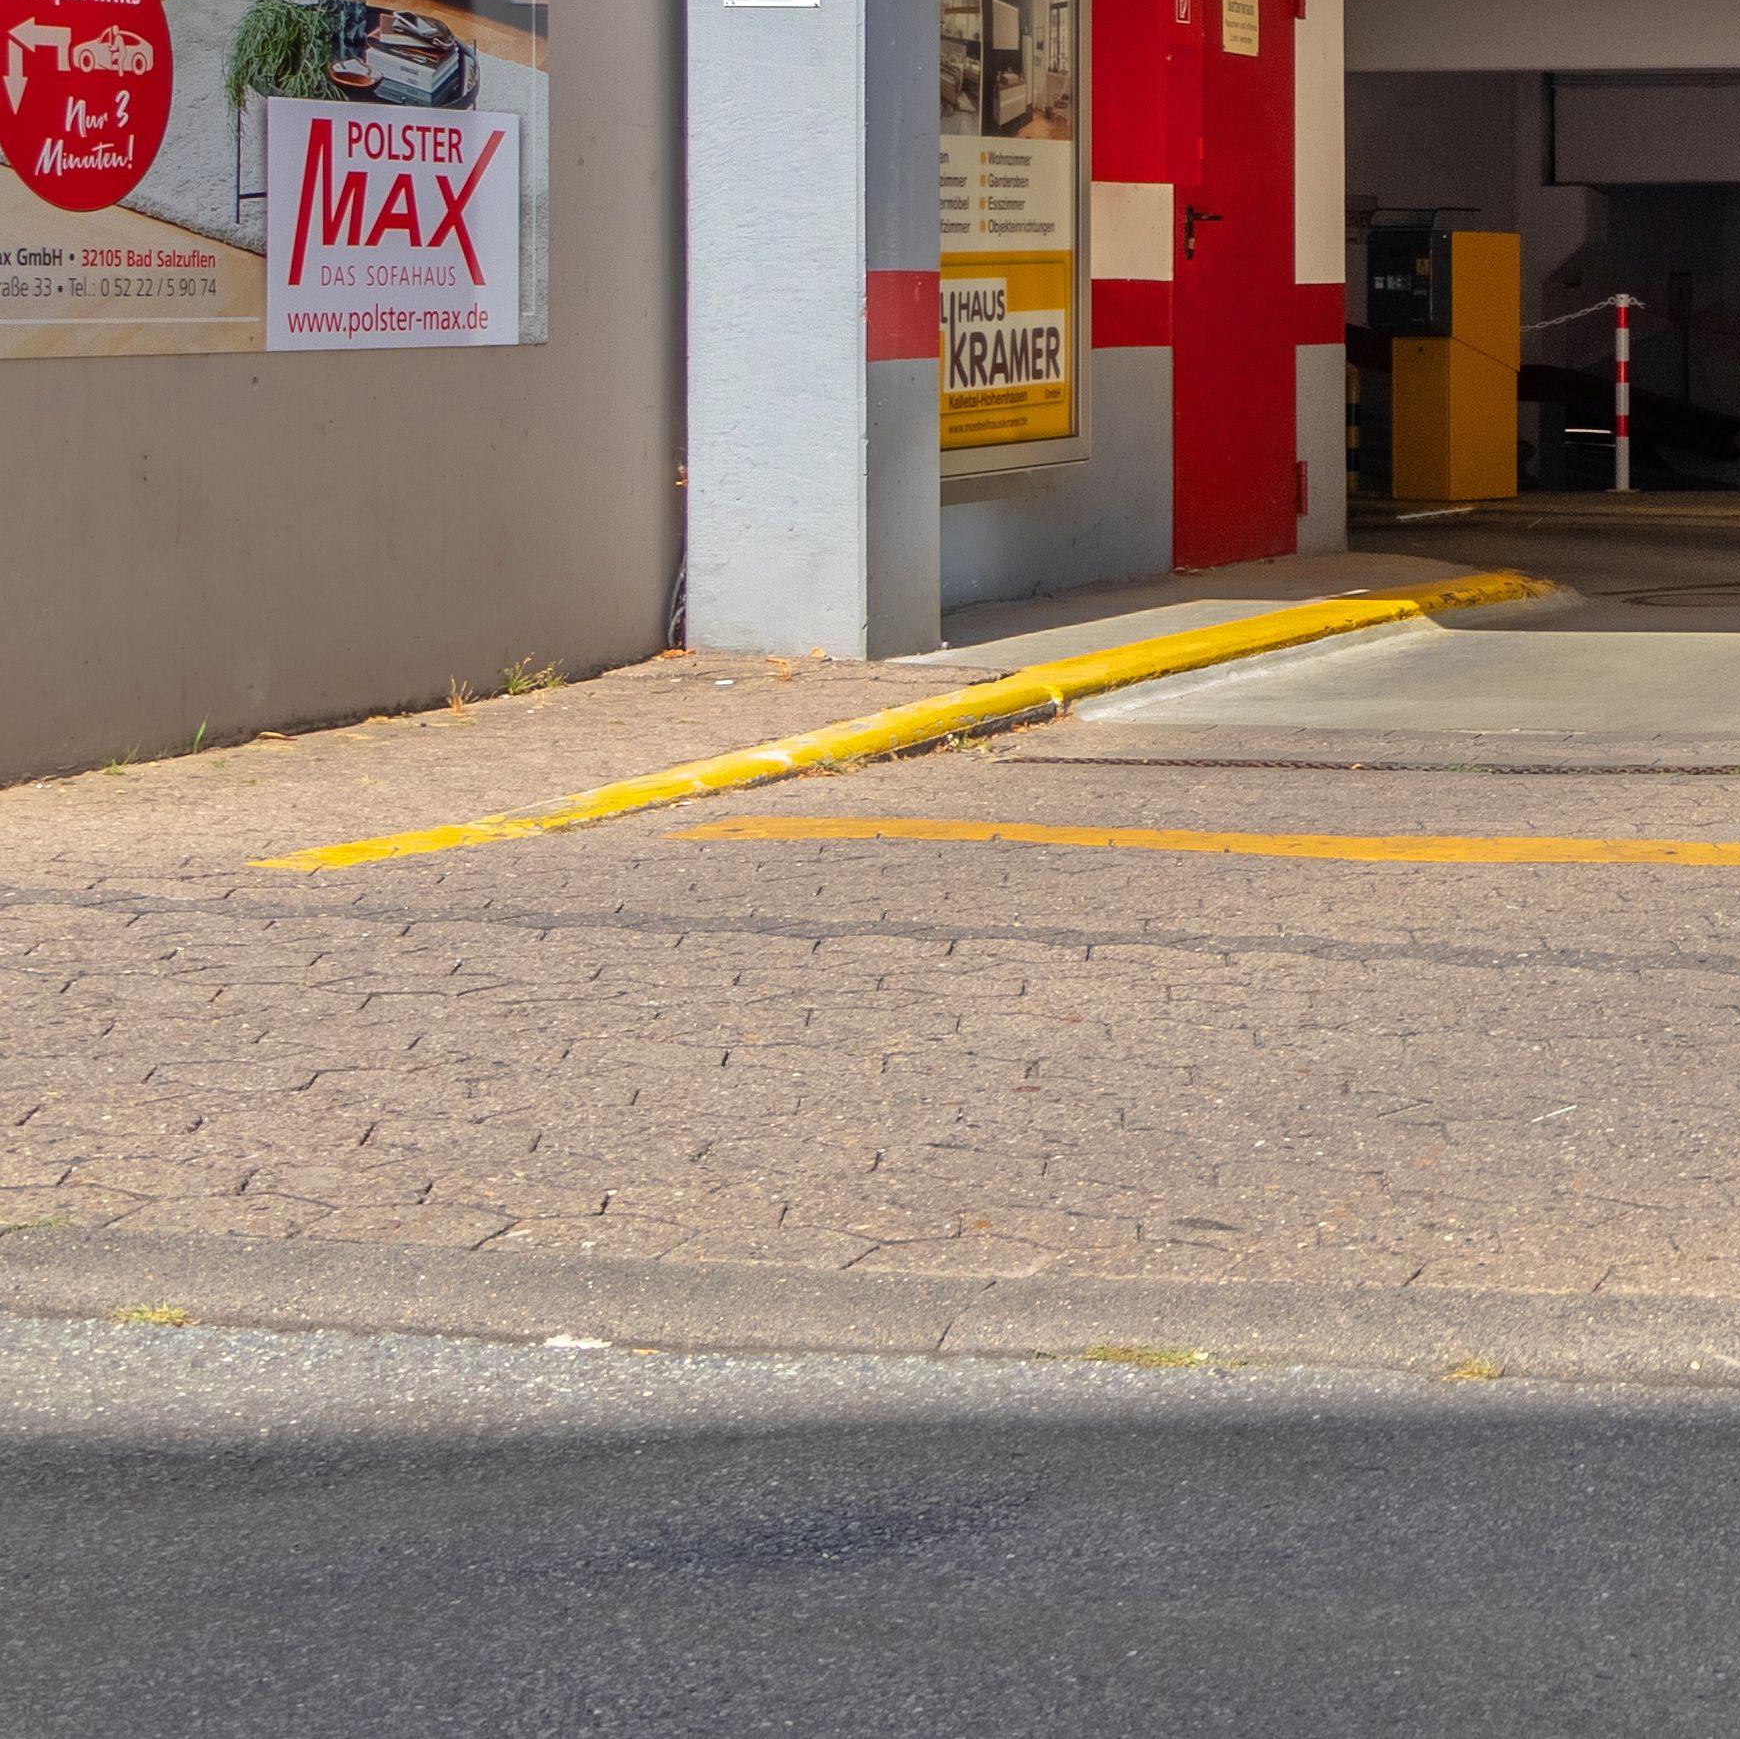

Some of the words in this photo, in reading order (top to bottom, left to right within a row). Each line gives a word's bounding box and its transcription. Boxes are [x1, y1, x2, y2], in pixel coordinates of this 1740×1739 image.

[65, 96, 109, 138] Nur
[115, 90, 131, 127] 3
[35, 134, 135, 177] Minuten!
[348, 121, 463, 164] POLSTER
[288, 118, 506, 286] MAX
[17, 247, 63, 267] GmbH
[81, 249, 122, 267] 32105
[126, 250, 152, 268] Bad
[157, 250, 216, 268] Salzuflen
[320, 265, 356, 287] DAS
[366, 265, 456, 287] SOFAHAUS
[33, 277, 52, 297] 33
[958, 289, 1005, 322] HAUS
[288, 303, 489, 340] www.polster-max.de
[950, 291, 1060, 389] KRAMER
